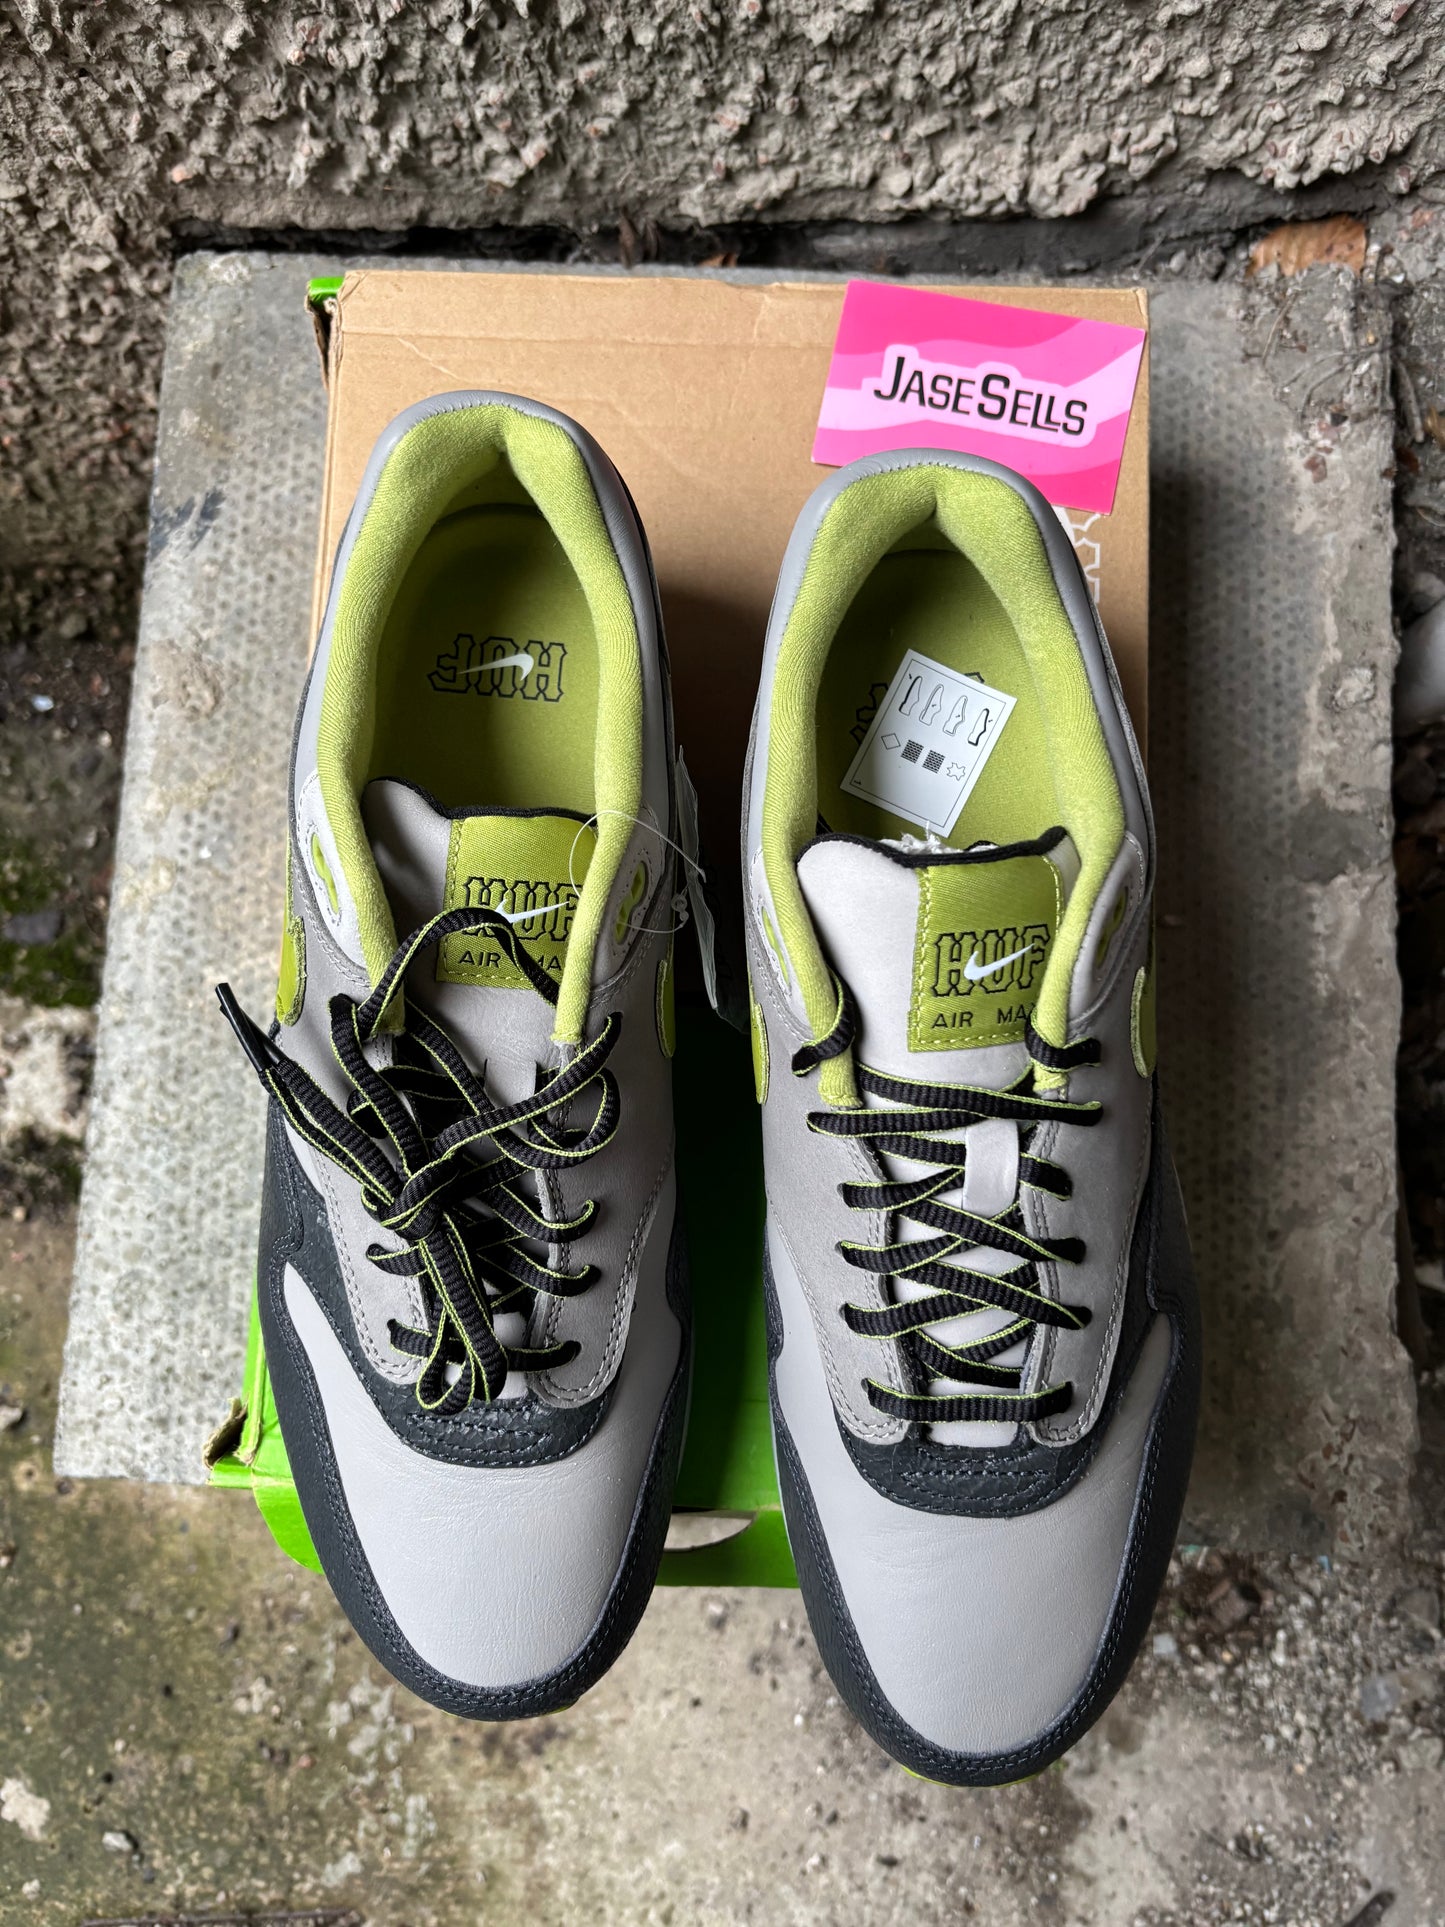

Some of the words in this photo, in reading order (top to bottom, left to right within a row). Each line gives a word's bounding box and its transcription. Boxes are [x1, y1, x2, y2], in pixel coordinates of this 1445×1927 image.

[427, 633, 567, 702] HUF
[459, 950, 501, 968] AIR
[931, 923, 1051, 997] HUF
[932, 1011, 974, 1029] AIR
